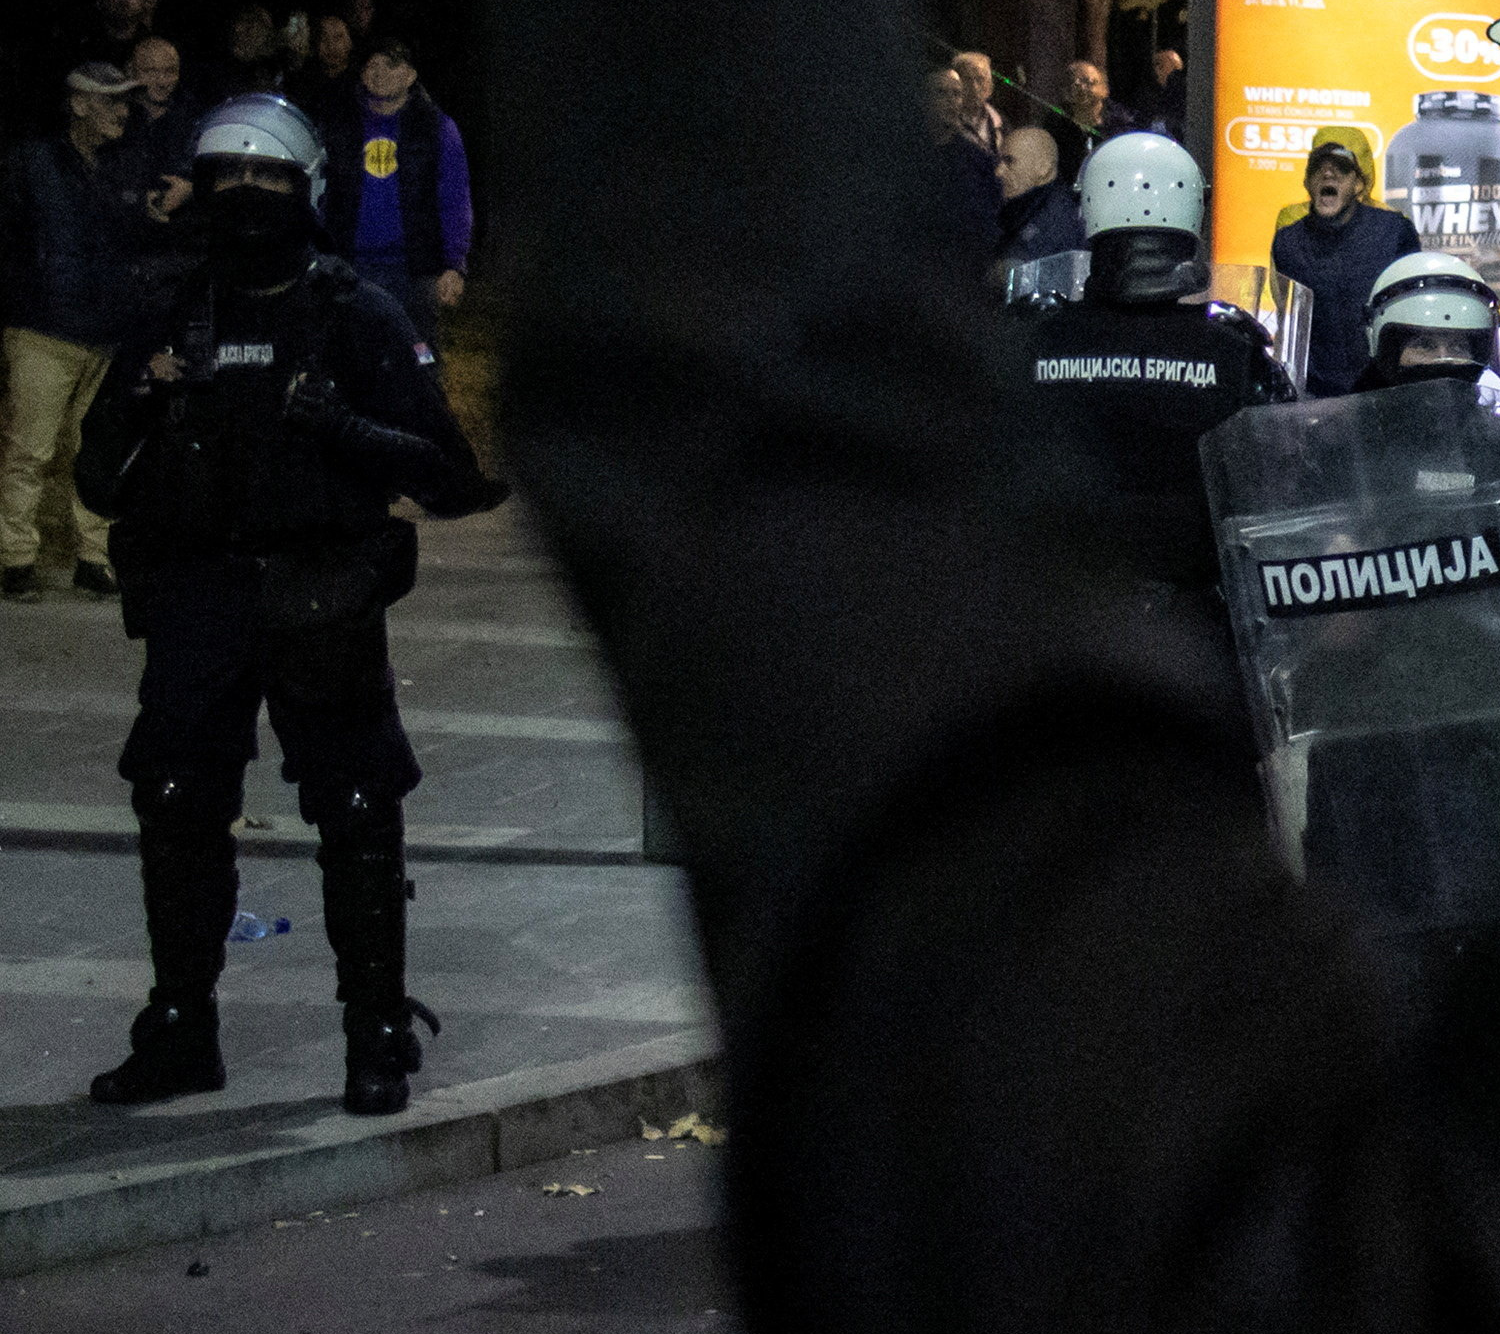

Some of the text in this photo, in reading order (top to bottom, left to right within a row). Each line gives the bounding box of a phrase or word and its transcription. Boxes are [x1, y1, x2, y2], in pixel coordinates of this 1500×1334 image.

[1244, 87, 1371, 107] WHEY PROTEIN
[1036, 357, 1217, 388] ПОЛИЦИЈСКА БРИГАДА
[1263, 534, 1499, 607] ПОЛИЦИЈА
